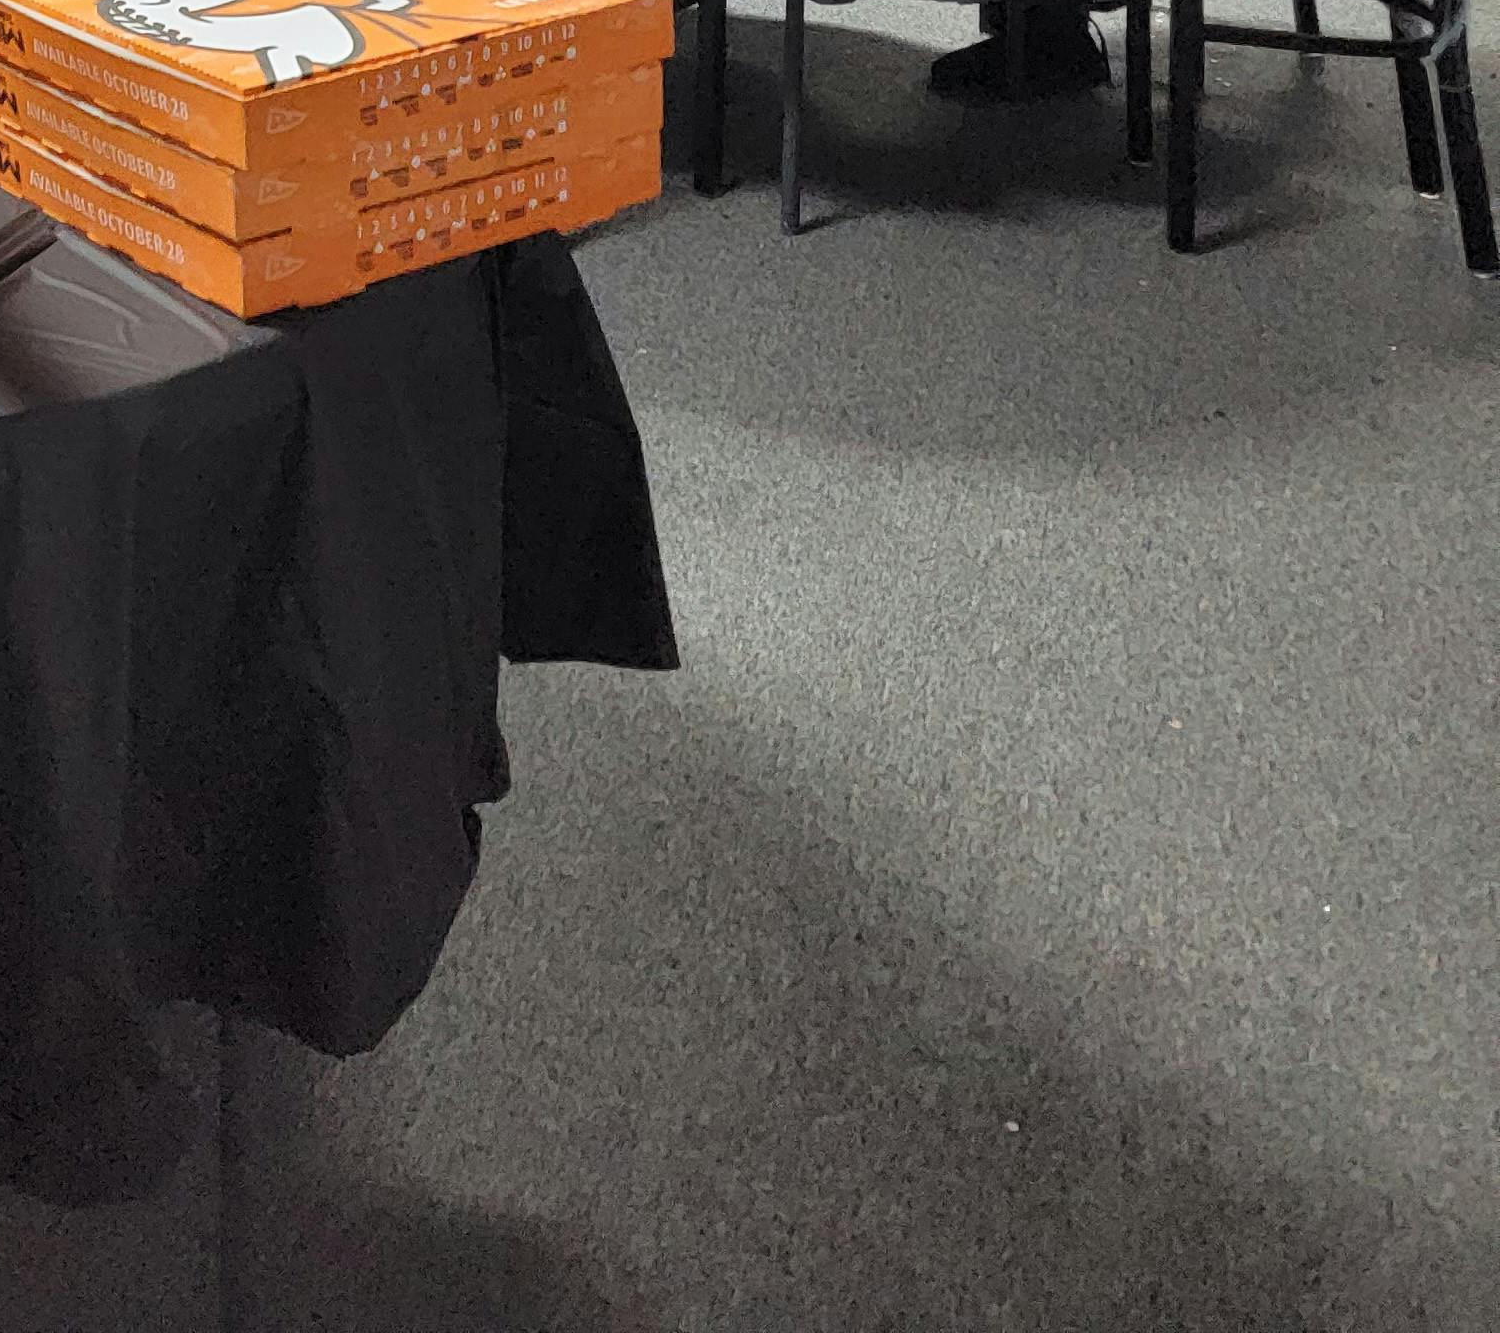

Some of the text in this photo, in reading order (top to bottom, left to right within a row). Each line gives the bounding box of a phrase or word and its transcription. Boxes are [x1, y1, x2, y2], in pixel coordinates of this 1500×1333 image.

[33, 37, 99, 82] AVAILABLE
[103, 69, 168, 113] OCTOBER
[171, 97, 188, 121] 28
[516, 35, 532, 51] 10
[542, 29, 553, 45] 11
[26, 101, 90, 147] AVAILABLE
[92, 138, 157, 180] OCTOBER
[157, 166, 176, 190] 28
[29, 169, 185, 265] AVAILABLE OCTOBER 28
